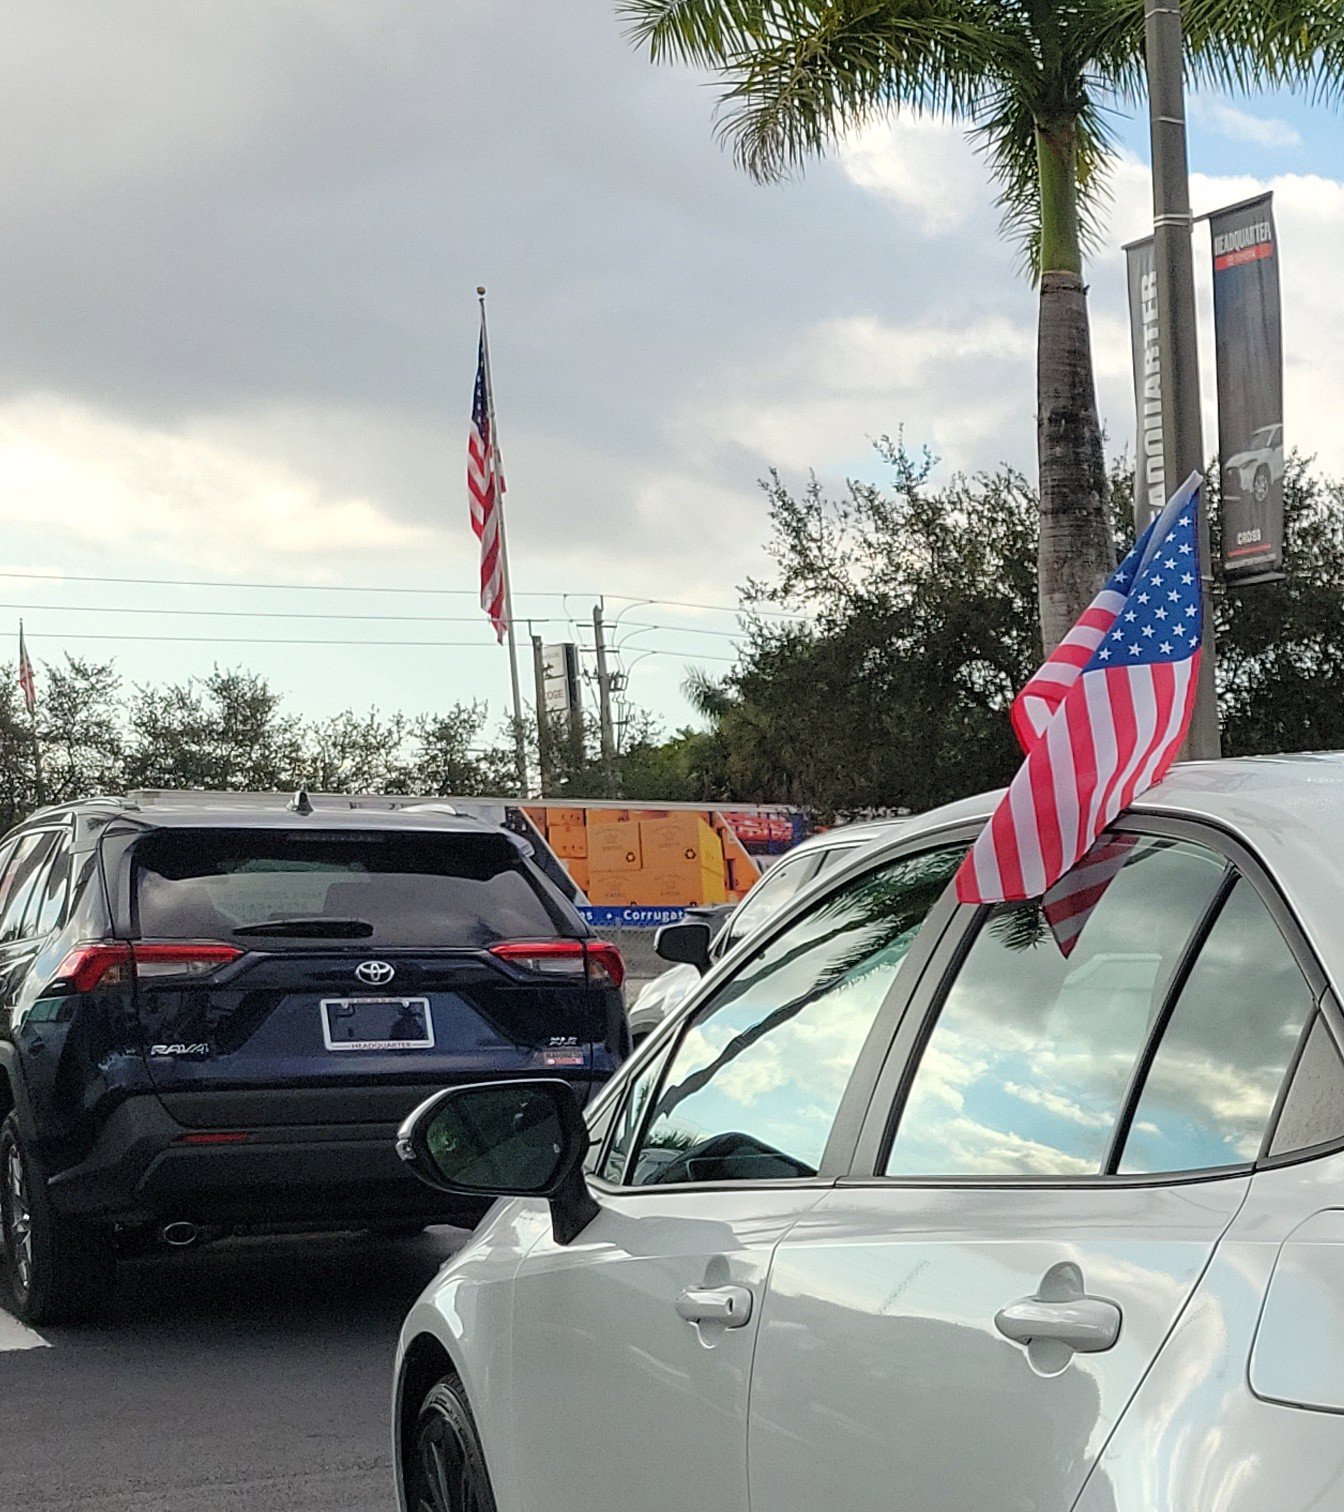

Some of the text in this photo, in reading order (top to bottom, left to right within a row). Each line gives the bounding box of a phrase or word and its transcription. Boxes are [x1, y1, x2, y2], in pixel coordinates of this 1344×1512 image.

[1141, 271, 1166, 521] ADQUARTER
[623, 909, 689, 923] Corrugat
[150, 1042, 210, 1056] RAV4
